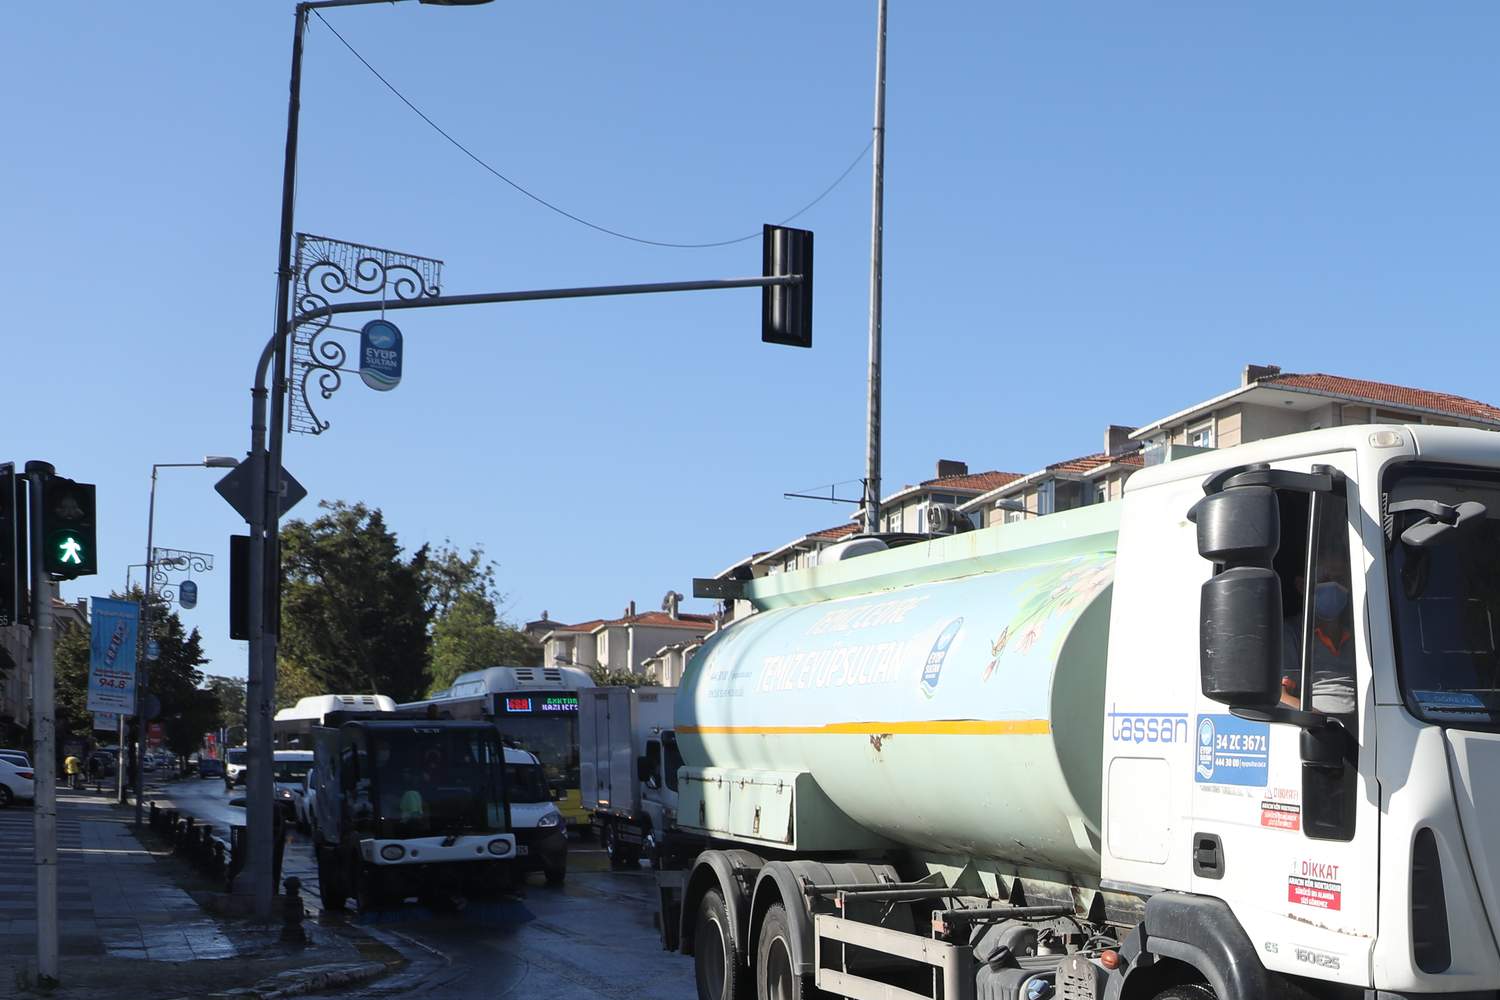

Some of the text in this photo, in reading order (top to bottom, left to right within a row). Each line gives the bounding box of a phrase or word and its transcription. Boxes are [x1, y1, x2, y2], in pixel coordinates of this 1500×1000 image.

[1216, 735, 1267, 751] 34 ZC 3671
[1302, 859, 1339, 880] DİKKAT
